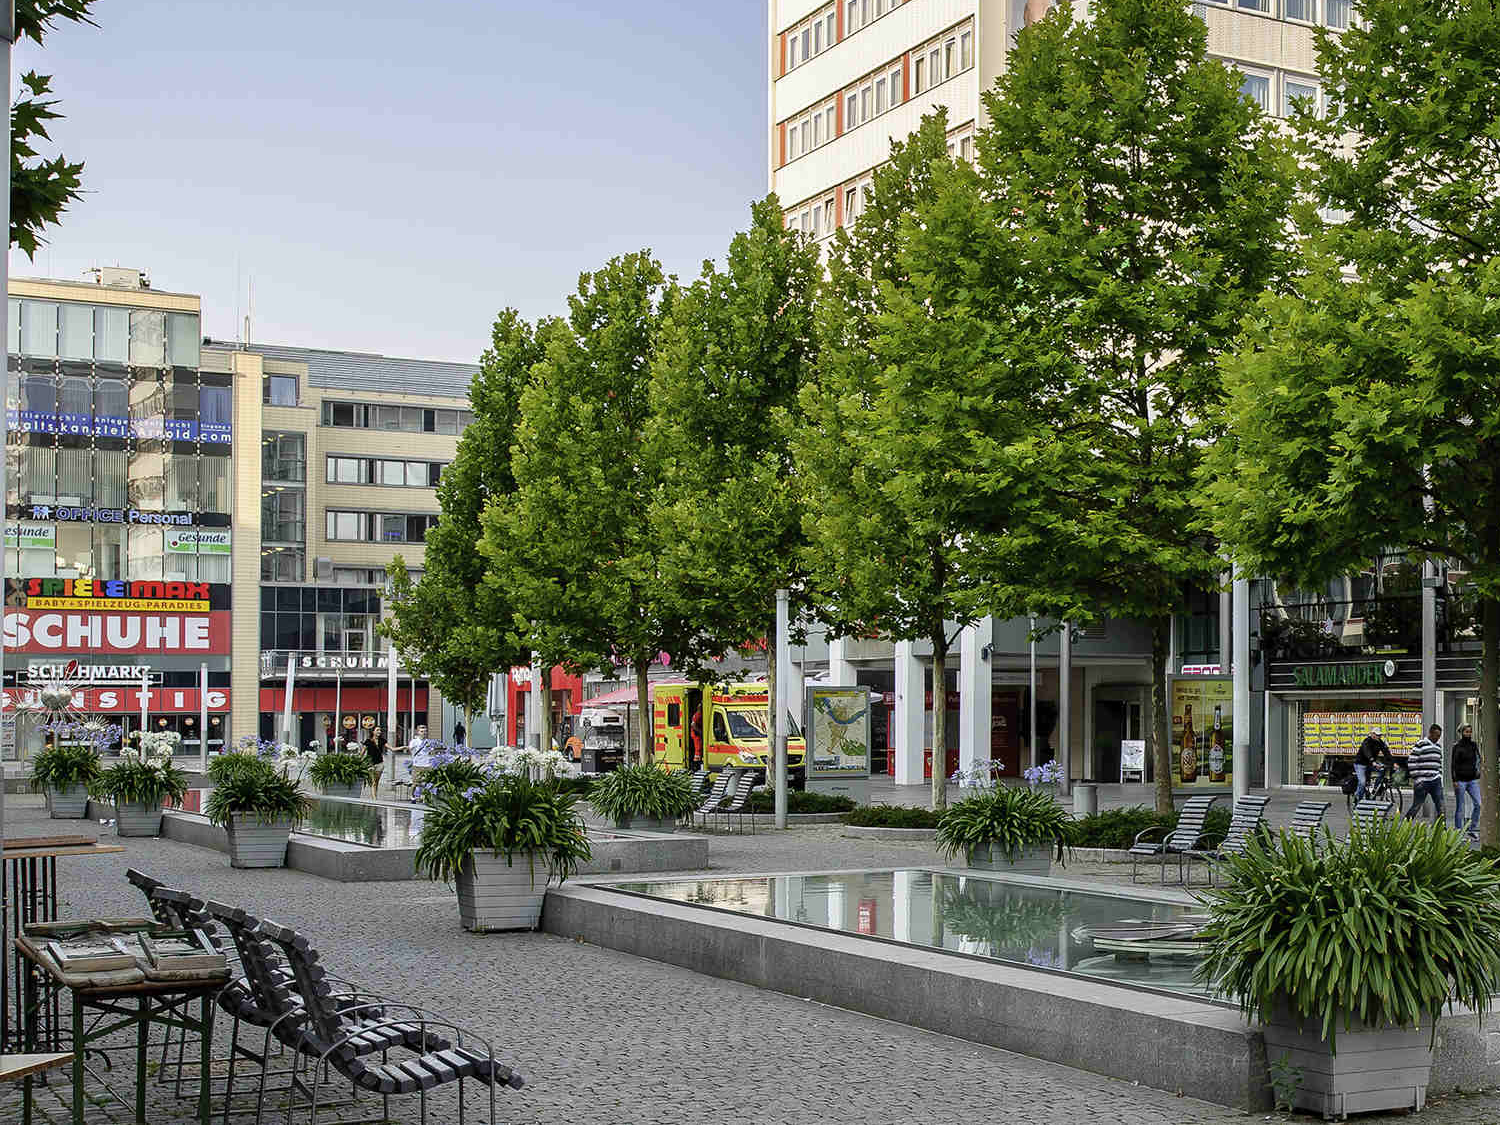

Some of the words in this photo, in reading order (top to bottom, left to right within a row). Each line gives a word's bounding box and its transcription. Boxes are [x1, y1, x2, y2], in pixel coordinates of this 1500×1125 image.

[56, 507, 124, 522] OFFICE
[129, 510, 192, 525] Personal
[3, 613, 210, 649] SCHUHE
[1294, 663, 1385, 686] SALAMANDER
